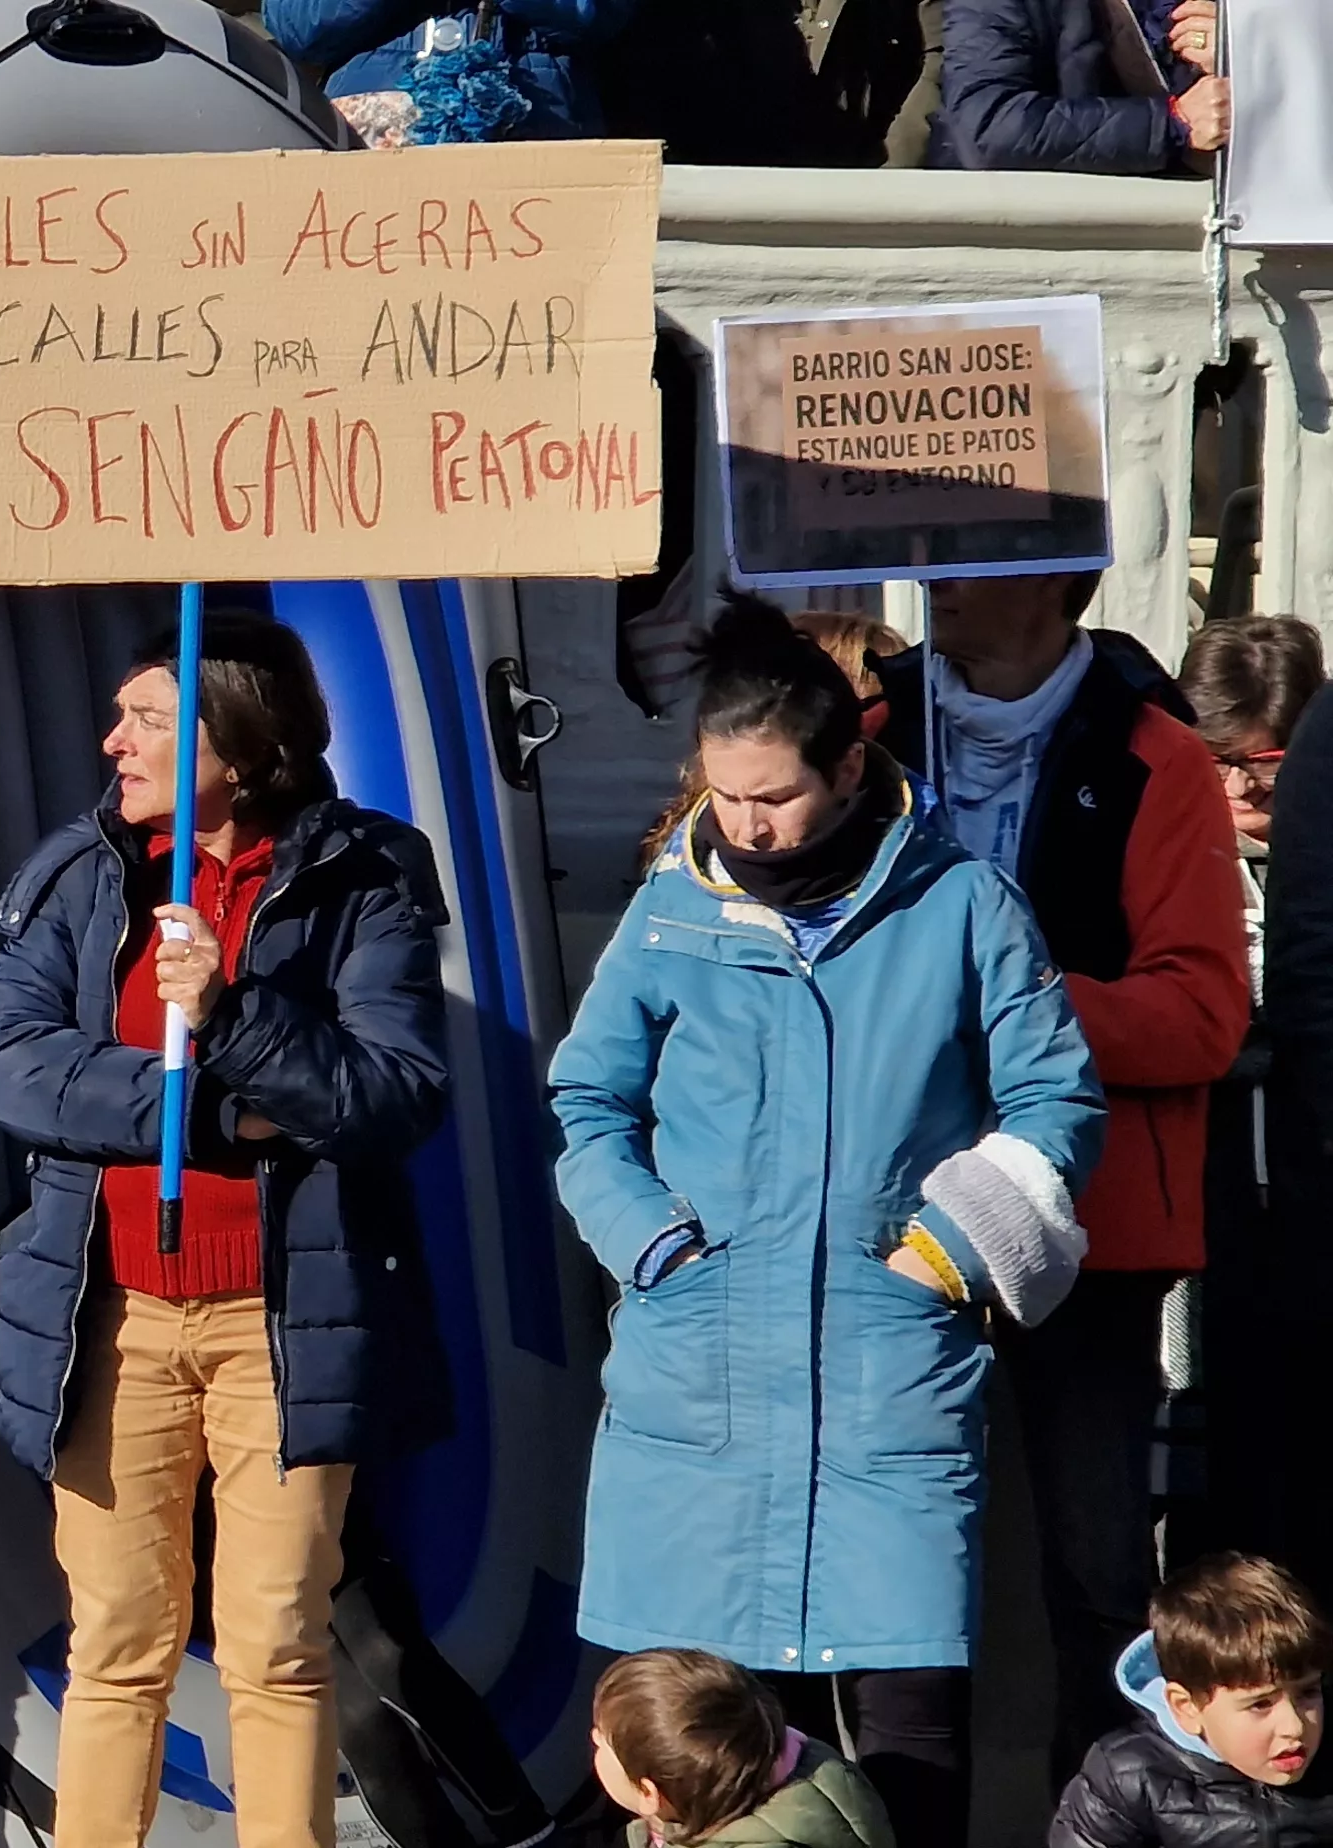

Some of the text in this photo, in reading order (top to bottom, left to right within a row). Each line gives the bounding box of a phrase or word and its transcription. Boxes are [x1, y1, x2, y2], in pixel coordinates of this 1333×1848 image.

[181, 201, 247, 269] SIN
[282, 187, 552, 275] ACERAS
[253, 337, 318, 387] PARA
[361, 291, 582, 385] ANDAR
[792, 342, 1034, 382] BARRIO SAN JOSE:
[795, 382, 1032, 429] RENOVACION
[431, 409, 664, 514] PEATONAL
[797, 426, 1036, 464] ESTANQUE DE PATOS
